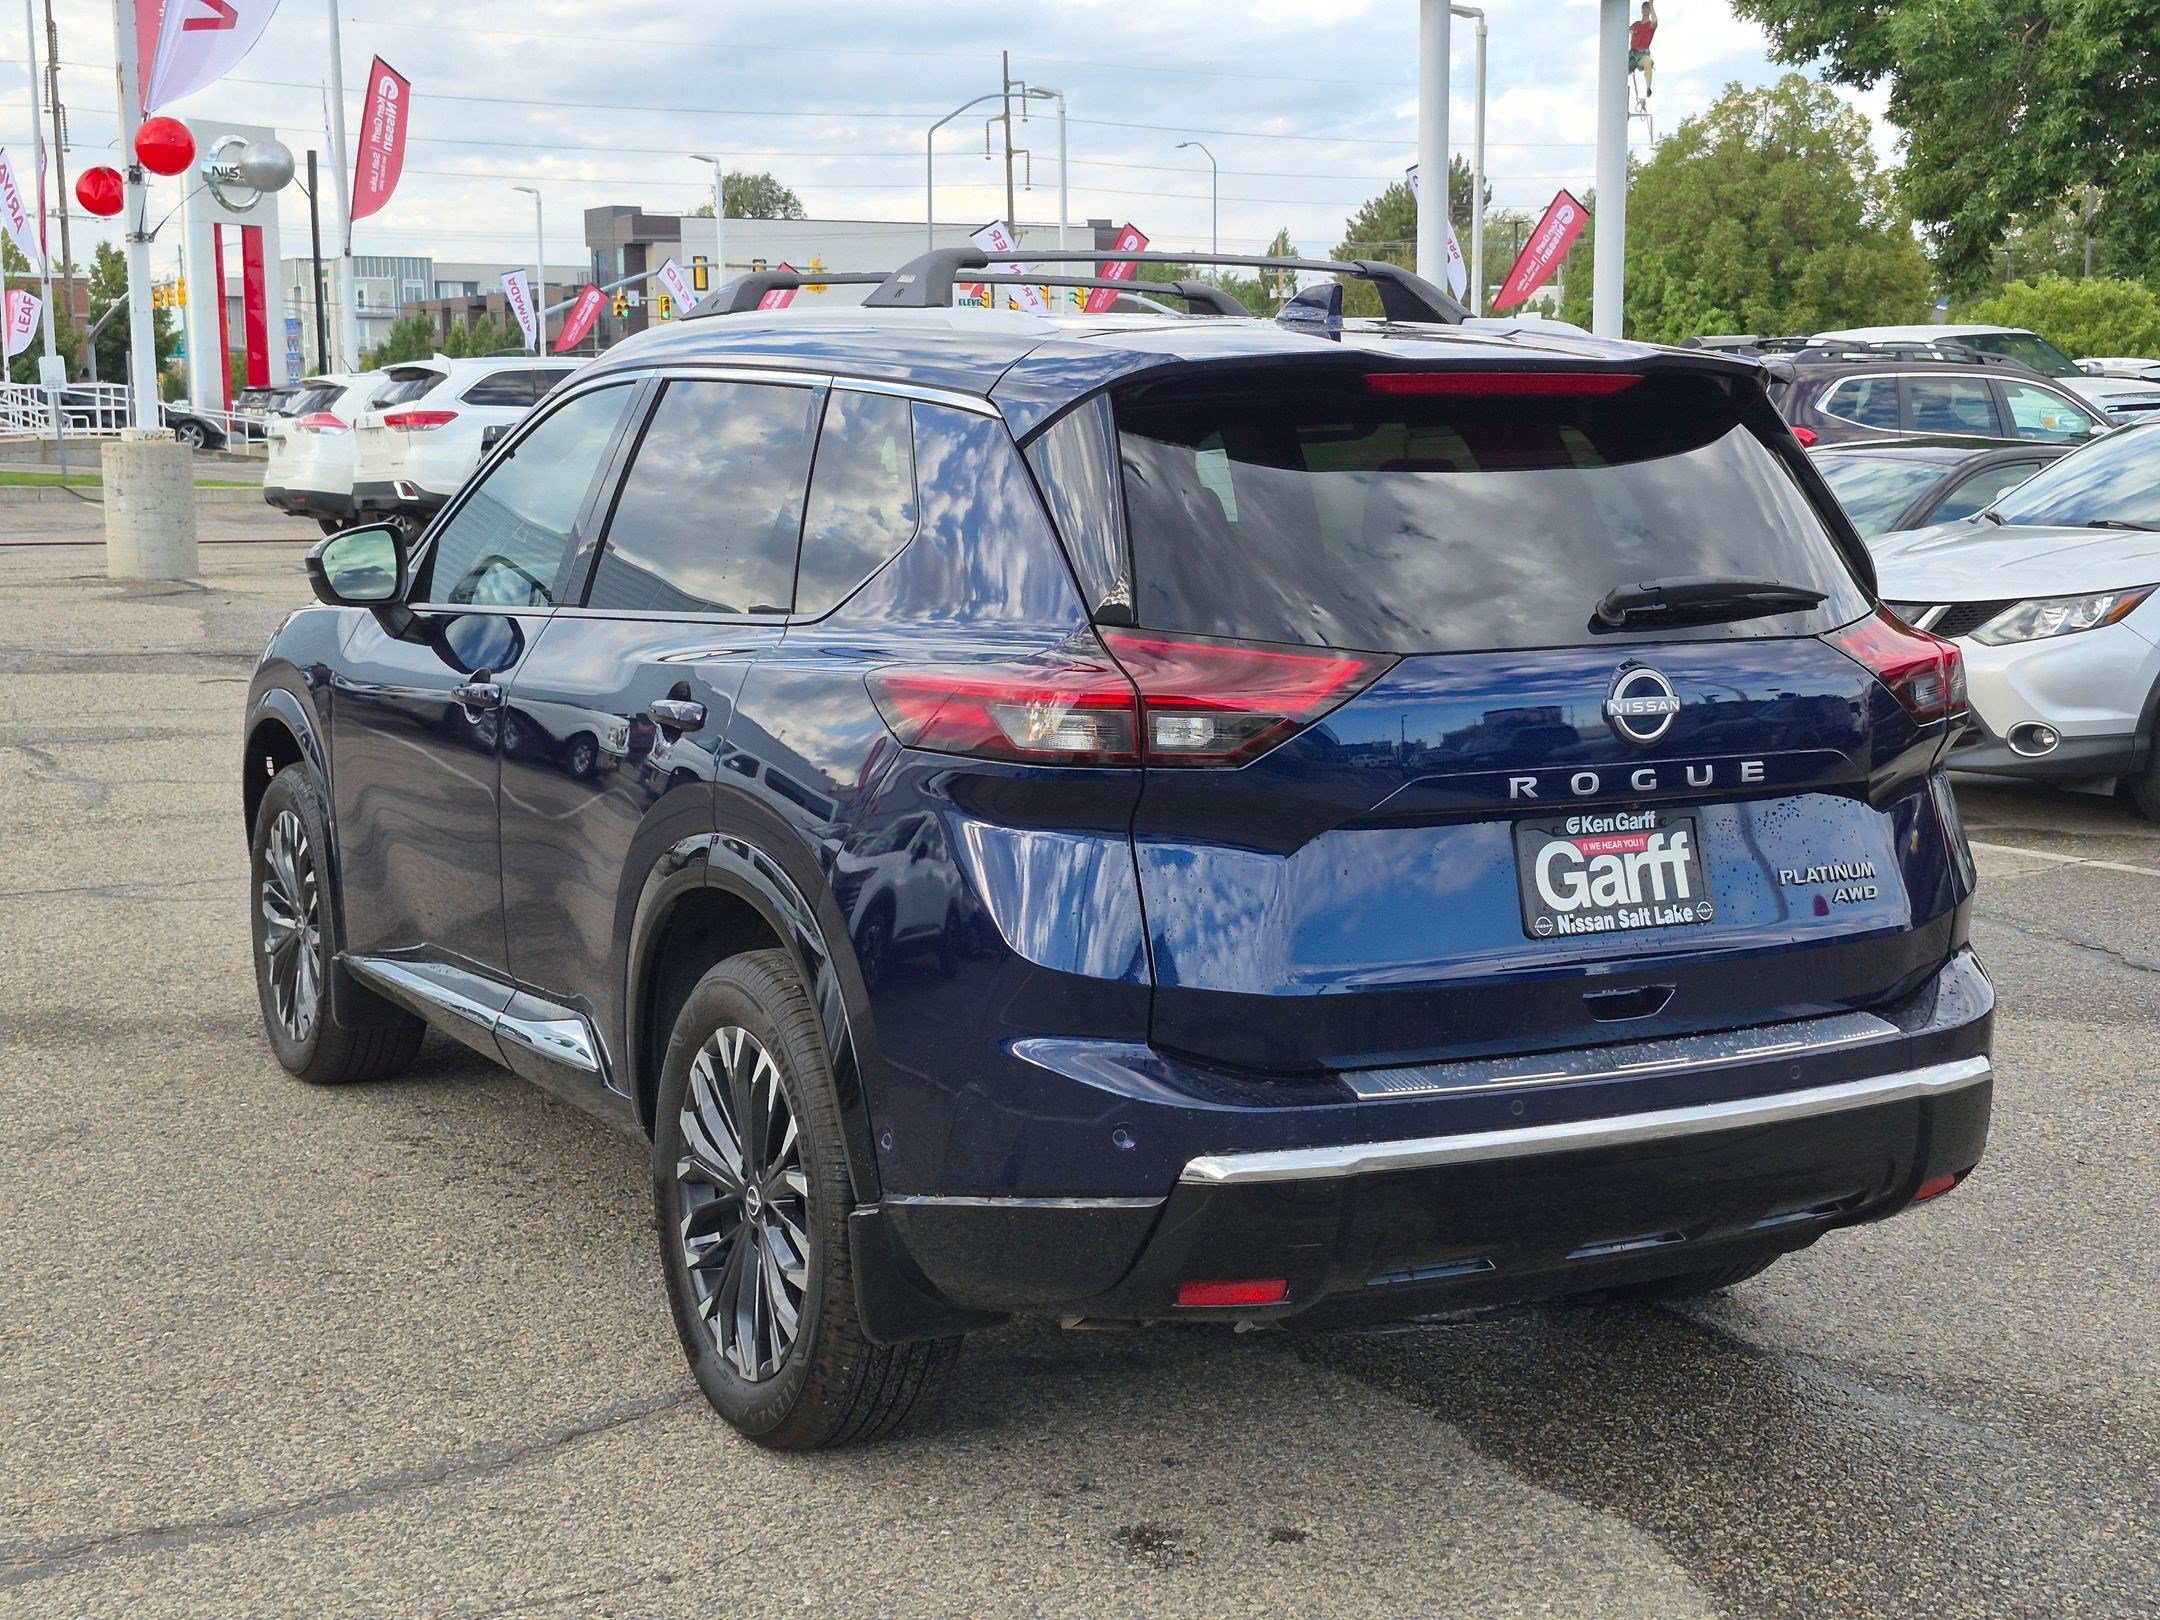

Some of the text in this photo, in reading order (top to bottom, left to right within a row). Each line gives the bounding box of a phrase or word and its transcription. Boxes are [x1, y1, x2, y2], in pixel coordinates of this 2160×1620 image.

[211, 165, 246, 179] NIS
[16, 296, 36, 334] LEAF
[1609, 699, 1680, 715] NISSAN
[1508, 761, 1766, 799] ROGUE
[1581, 811, 1656, 834] Ken Garff
[1602, 839, 1623, 849] HEAR
[1623, 838, 1640, 848] YOU
[1535, 830, 1691, 912] Garff
[1778, 861, 1876, 886] PLATINUM
[1832, 885, 1879, 903] AWD
[1556, 904, 1694, 935] Nissan Salt Lake
